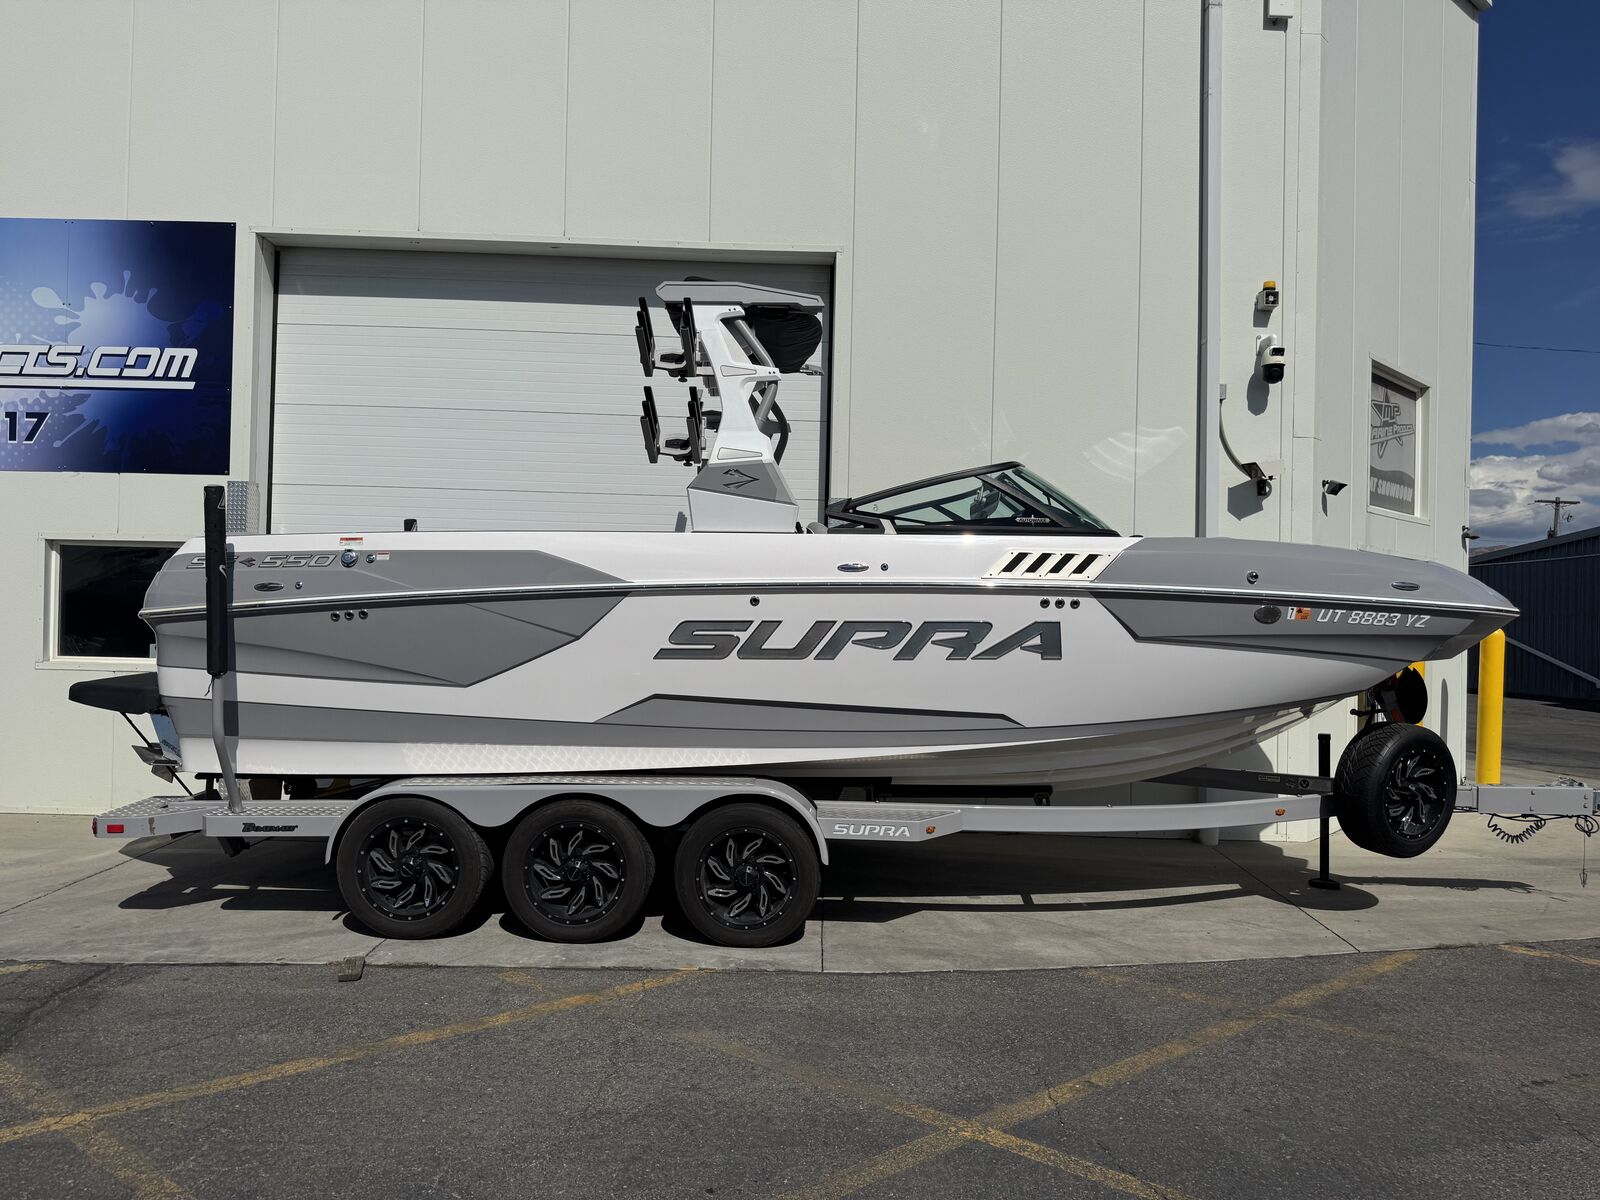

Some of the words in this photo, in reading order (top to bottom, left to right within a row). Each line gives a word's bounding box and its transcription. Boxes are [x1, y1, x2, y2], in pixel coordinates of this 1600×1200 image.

[5, 411, 51, 444] 17
[1371, 426, 1393, 440] ARINE
[258, 554, 337, 569] 550
[1316, 609, 1346, 623] UT
[1347, 610, 1401, 626] 8883
[1405, 614, 1431, 628] YZ
[653, 620, 1062, 661] SUPRA
[832, 824, 910, 837] SUPRA
